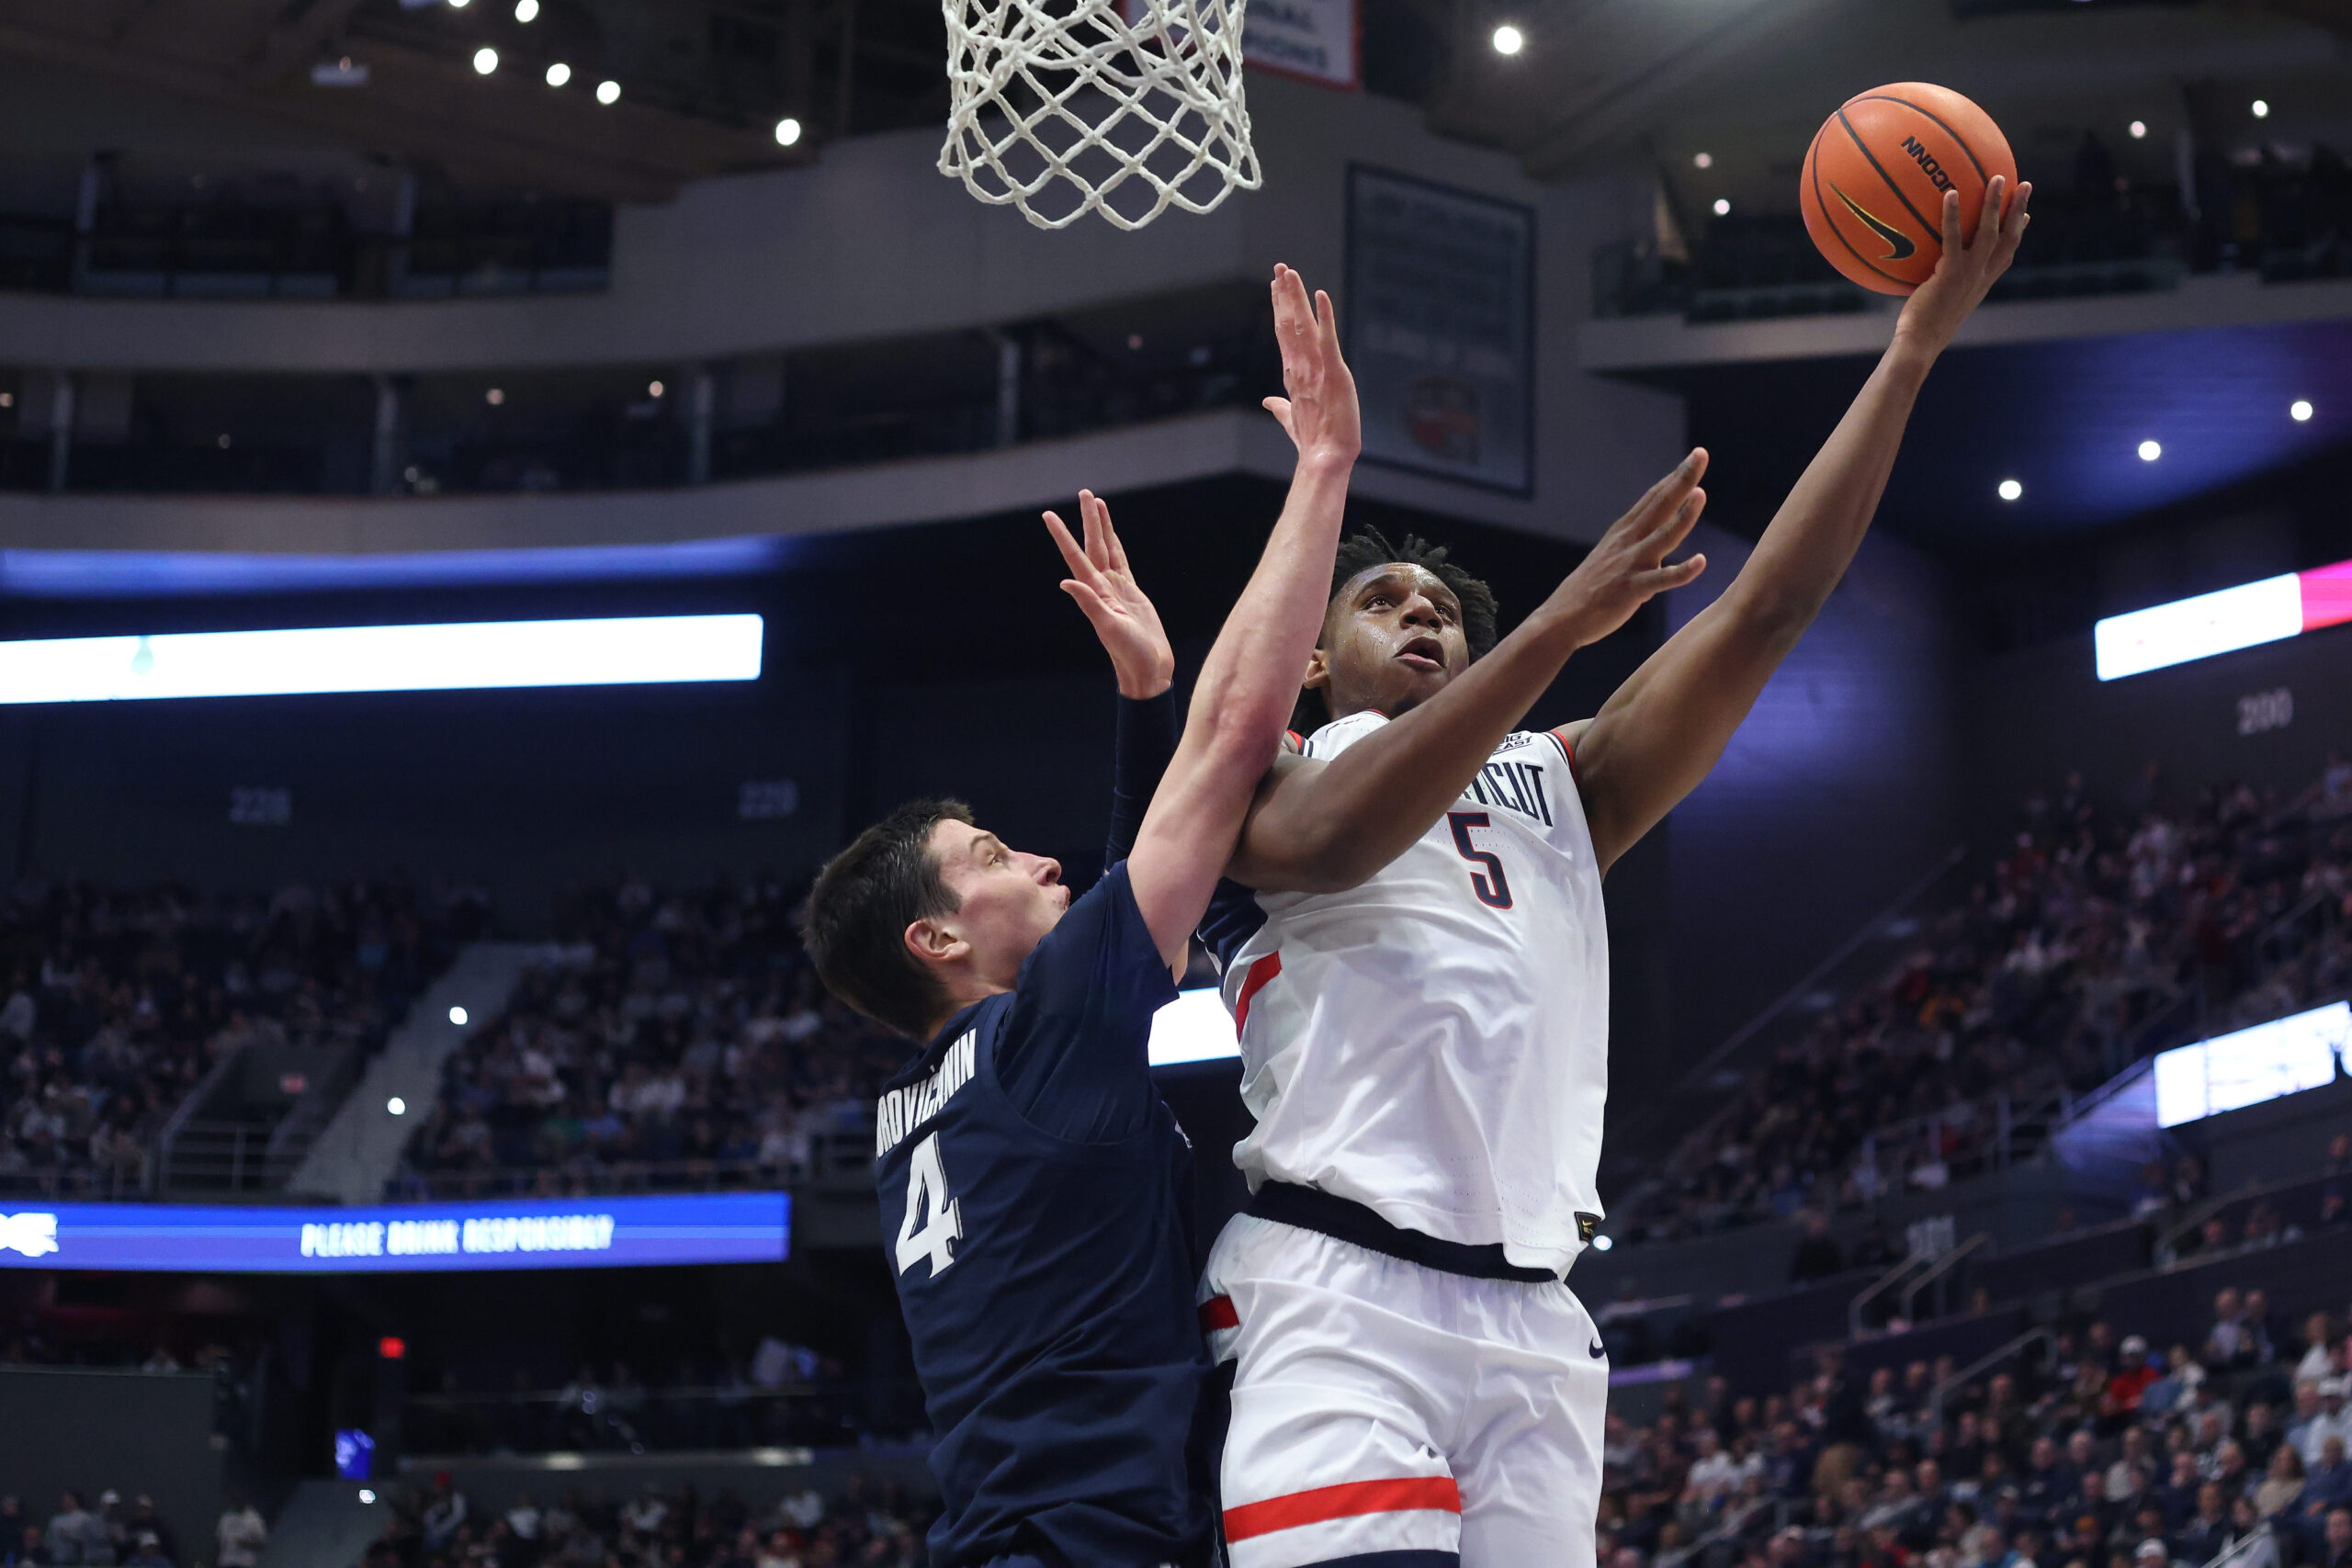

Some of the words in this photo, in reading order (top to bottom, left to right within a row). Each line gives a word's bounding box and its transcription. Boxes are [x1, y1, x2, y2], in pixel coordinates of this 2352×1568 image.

[1447, 812, 1513, 909] 5
[300, 1222, 384, 1257] PLEASE
[387, 1220, 459, 1255] DRINK
[462, 1214, 615, 1253] RESPONSIBLY
[895, 1130, 963, 1279] 4
